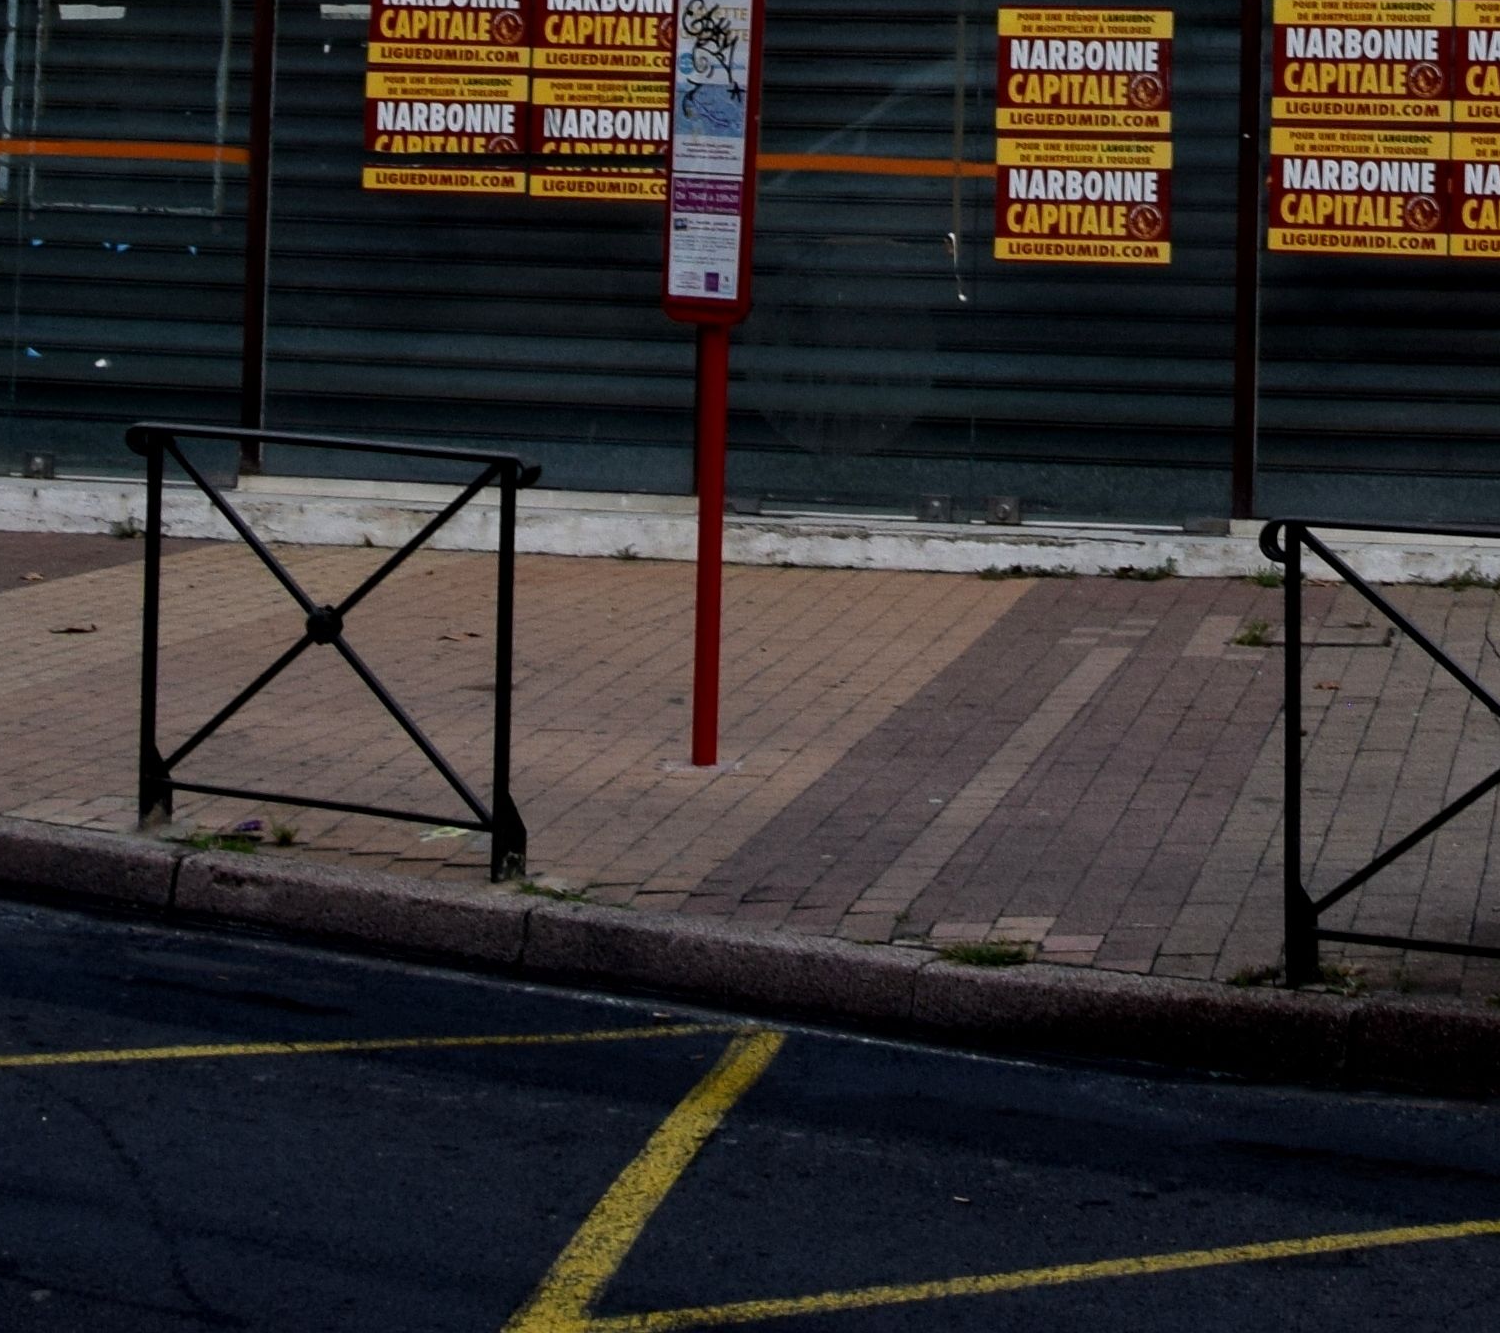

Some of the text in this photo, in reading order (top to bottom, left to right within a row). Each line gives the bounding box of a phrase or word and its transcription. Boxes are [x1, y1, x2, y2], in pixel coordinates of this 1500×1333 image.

[1380, 2, 1436, 11] LANGUEDOC
[1475, 3, 1500, 12] POUR
[1017, 13, 1041, 21] POUR
[1102, 15, 1156, 23] LANGUEDOC
[1298, 12, 1308, 20] DE
[1312, 13, 1372, 21] MONTPELLIER
[1386, 14, 1431, 22] TOULOUSE
[1479, 16, 1490, 24] DE
[380, 9, 491, 41] CAPITALE
[544, 15, 658, 46] CAPITALE
[1036, 25, 1094, 33] MONTPELLIER
[1108, 26, 1151, 34] TOULOUSE
[1286, 27, 1438, 60] NARBONNE
[381, 47, 520, 62] LIGUEDUMIDI.COM
[546, 53, 671, 67] LIGUEDUMIDI.CO
[1010, 39, 1159, 71] NARBONNE
[384, 76, 407, 84] POUR
[463, 78, 513, 86] LANGUEDOC
[1284, 62, 1407, 94] CAPITALE
[388, 87, 398, 95] DE
[401, 87, 456, 96] MONTPELLIER
[467, 89, 508, 97] TOULOUSE
[551, 83, 573, 91] POUR
[1008, 74, 1129, 105] CAPITALE
[568, 94, 624, 102] MONTPELLIER
[1286, 102, 1440, 116] LIGUEDUMIDI.COM
[377, 101, 515, 134] NARBONNE
[544, 108, 669, 141] NARBONN
[1010, 112, 1160, 127] LIGUEDUMIDI.COM
[1289, 132, 1315, 140] POUR
[1378, 134, 1433, 143] LANGUEDOC
[1471, 136, 1497, 144] POUR
[1043, 143, 1061, 151] UNE
[1101, 144, 1155, 153] LANGUEDOC
[1309, 144, 1370, 153] MONTPELLIER
[1383, 146, 1428, 155] TOULOUSE
[1034, 155, 1093, 163] MONTPELLIER
[1107, 156, 1151, 164] TOULOUSE
[376, 173, 515, 187] LIGUEDUMIDI.COM
[1283, 158, 1436, 193] NARBONNE
[542, 180, 667, 195] LIGUEDUMIDI.CO
[1009, 169, 1158, 202] NARBONNE
[1281, 193, 1404, 227] CAPITALE
[1007, 203, 1127, 236] CAPITALE
[1282, 233, 1436, 250] LIGUEDUMIDI.COM
[1009, 242, 1159, 257] LIGUEDUMIDI.COM
